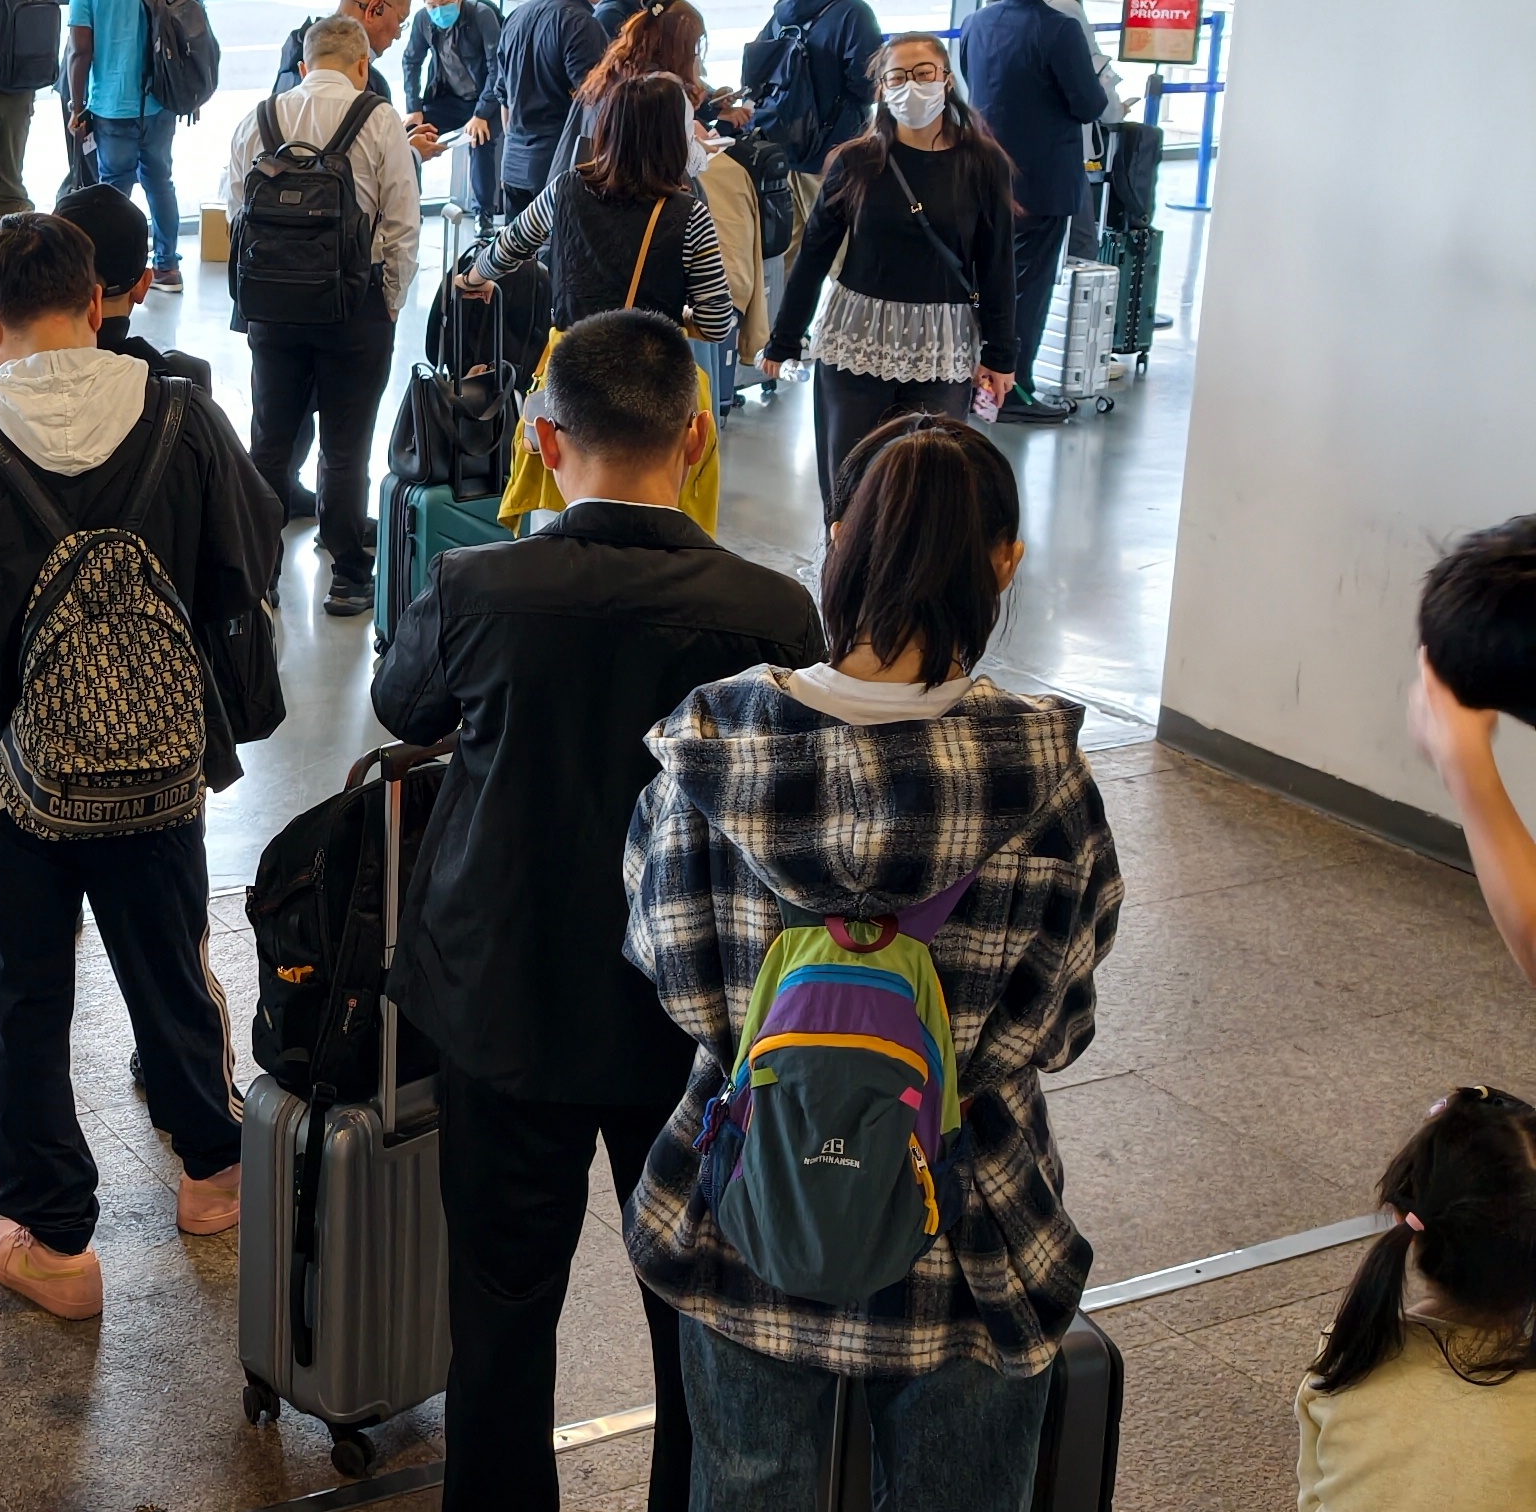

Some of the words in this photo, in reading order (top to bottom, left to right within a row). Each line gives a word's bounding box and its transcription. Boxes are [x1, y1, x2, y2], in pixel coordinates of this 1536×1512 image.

[1129, 8, 1191, 20] PRIORITY
[48, 796, 145, 821] CHRISTIAN
[154, 783, 190, 812] DIOR
